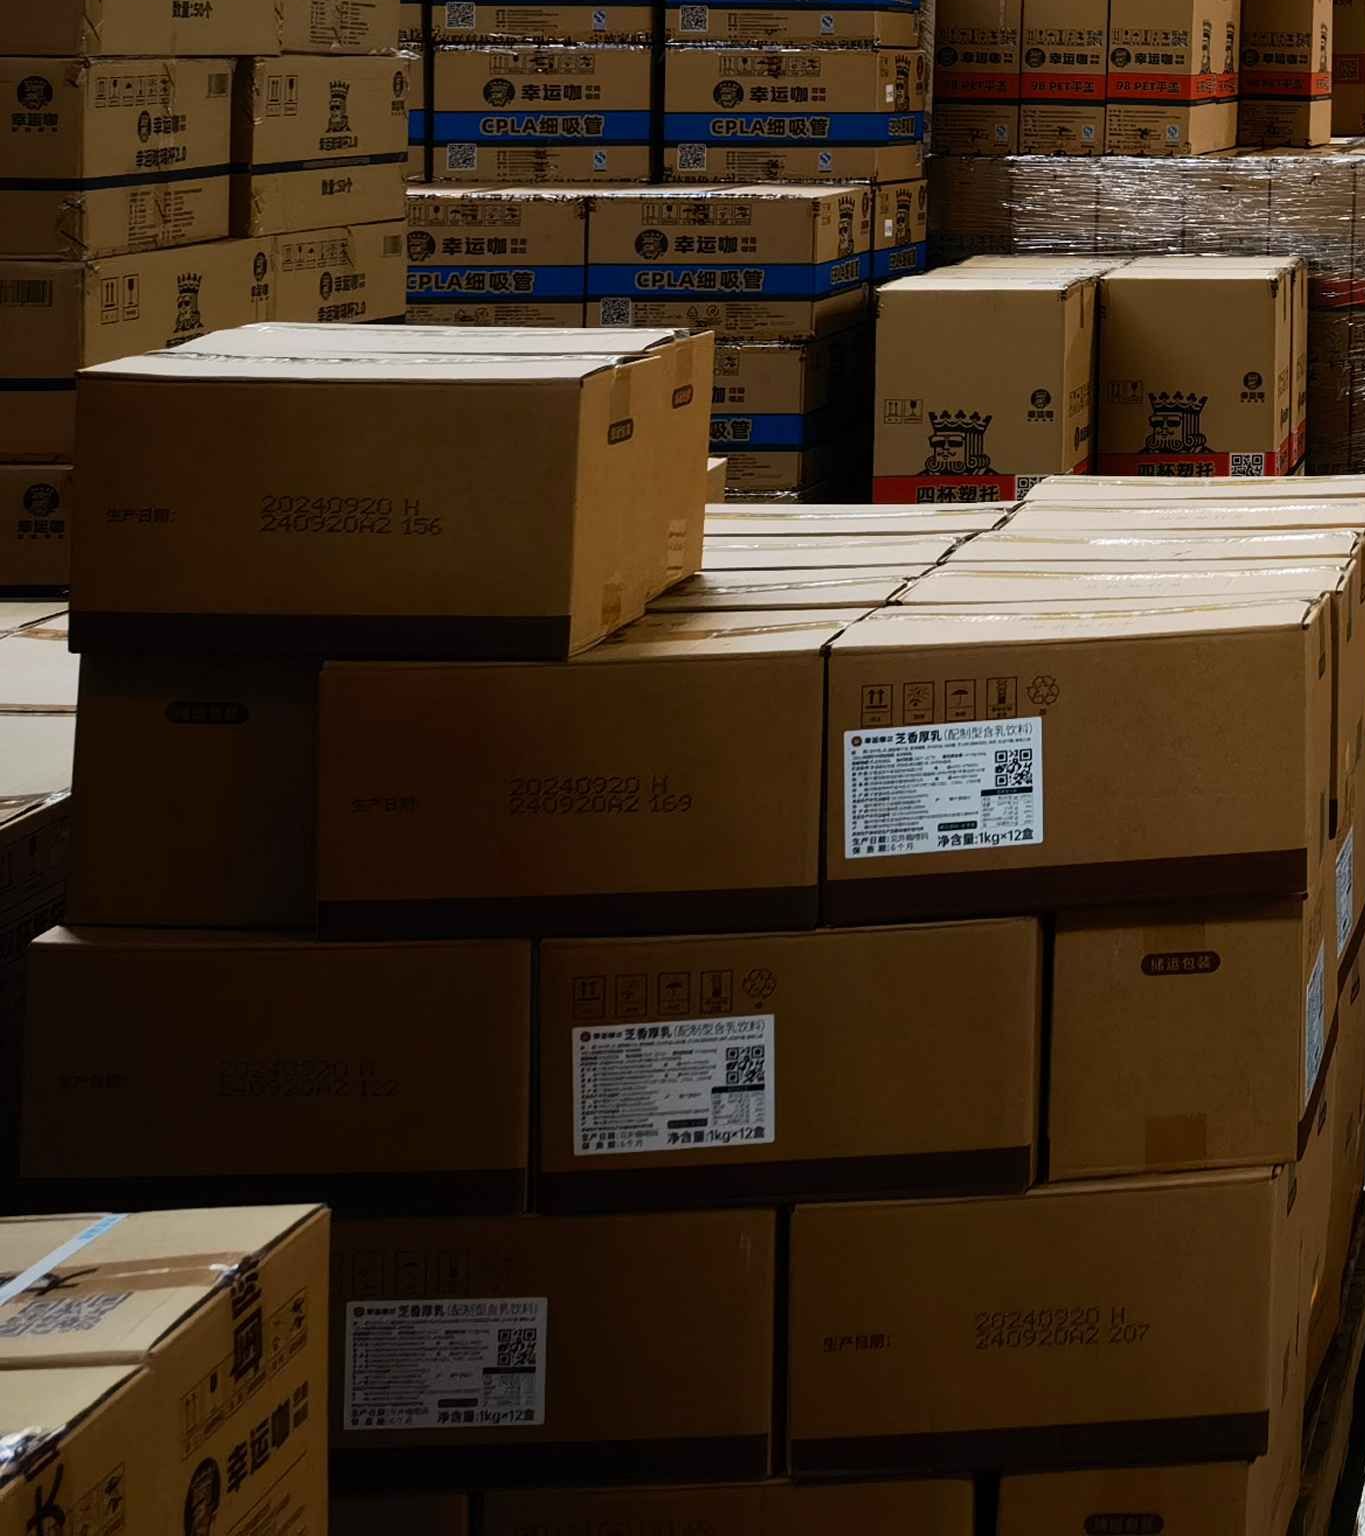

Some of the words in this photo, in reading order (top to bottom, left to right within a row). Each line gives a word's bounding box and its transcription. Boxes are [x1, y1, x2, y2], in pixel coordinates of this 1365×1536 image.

[520, 84, 583, 101] 幸运咖
[749, 85, 809, 103] 幸运咖
[480, 117, 604, 137] CPLA细吸管
[711, 117, 830, 138] CPLA细吸管
[441, 236, 507, 256] 幸运咖
[673, 236, 738, 255] 幸运咖
[636, 269, 765, 291] CPLA细吸管
[916, 485, 999, 503] 四杯塑托
